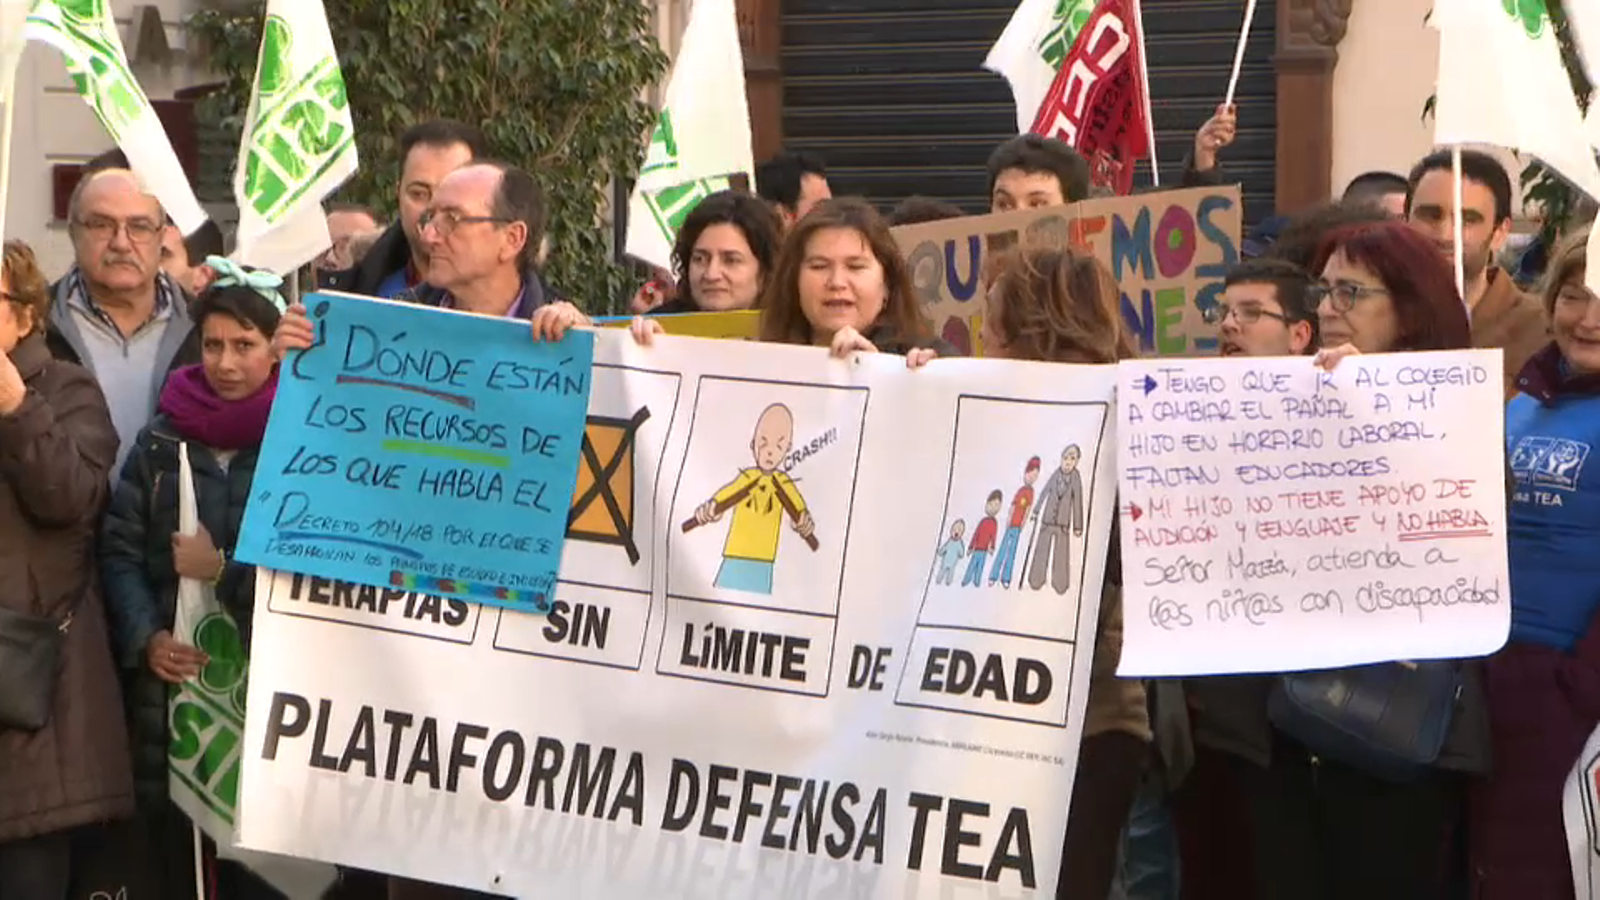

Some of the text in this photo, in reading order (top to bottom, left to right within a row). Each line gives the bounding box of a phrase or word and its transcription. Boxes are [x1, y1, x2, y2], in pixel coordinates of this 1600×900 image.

[486, 356, 585, 396] ESTÁN
[1157, 364, 1488, 395] TENGO QUE IR AL COLEGIO
[304, 396, 562, 457] LOS RECURSOS DE
[1129, 402, 1143, 425] A
[1152, 399, 1237, 424] CAMBIAR
[1240, 401, 1273, 420] EL
[1280, 393, 1355, 422] PAÑAL
[1374, 392, 1391, 413] A
[783, 427, 837, 472] CRASH!!
[1129, 420, 1447, 459] HIJO EN HORARIO LABORAL,
[281, 446, 552, 514] LOS QUE HABLA EL
[1126, 466, 1220, 491] FALTAN
[1184, 494, 1233, 519] HIJO
[1247, 495, 1274, 515] NO
[1278, 489, 1346, 510] TIENE
[1358, 480, 1427, 507] APOYO
[1432, 478, 1476, 500] DE
[1533, 490, 1563, 507] TEA
[443, 524, 475, 547] POR
[1134, 519, 1219, 547] AUDICIÓN
[1256, 515, 1361, 541] LENGUAJE
[1397, 511, 1423, 532] NO
[1144, 554, 1214, 588] Señor
[1307, 541, 1418, 572] atienda
[1424, 546, 1460, 566] a
[1206, 587, 1284, 627] niñ@s
[1300, 589, 1344, 616] con
[1355, 575, 1501, 624] discapacidad
[288, 571, 470, 627] TERAPIAS
[542, 600, 612, 650] SIN
[847, 644, 892, 692] DE
[920, 646, 1053, 706] EDAD
[260, 690, 1037, 890] PLATAFORMA DEFENSA TEA
